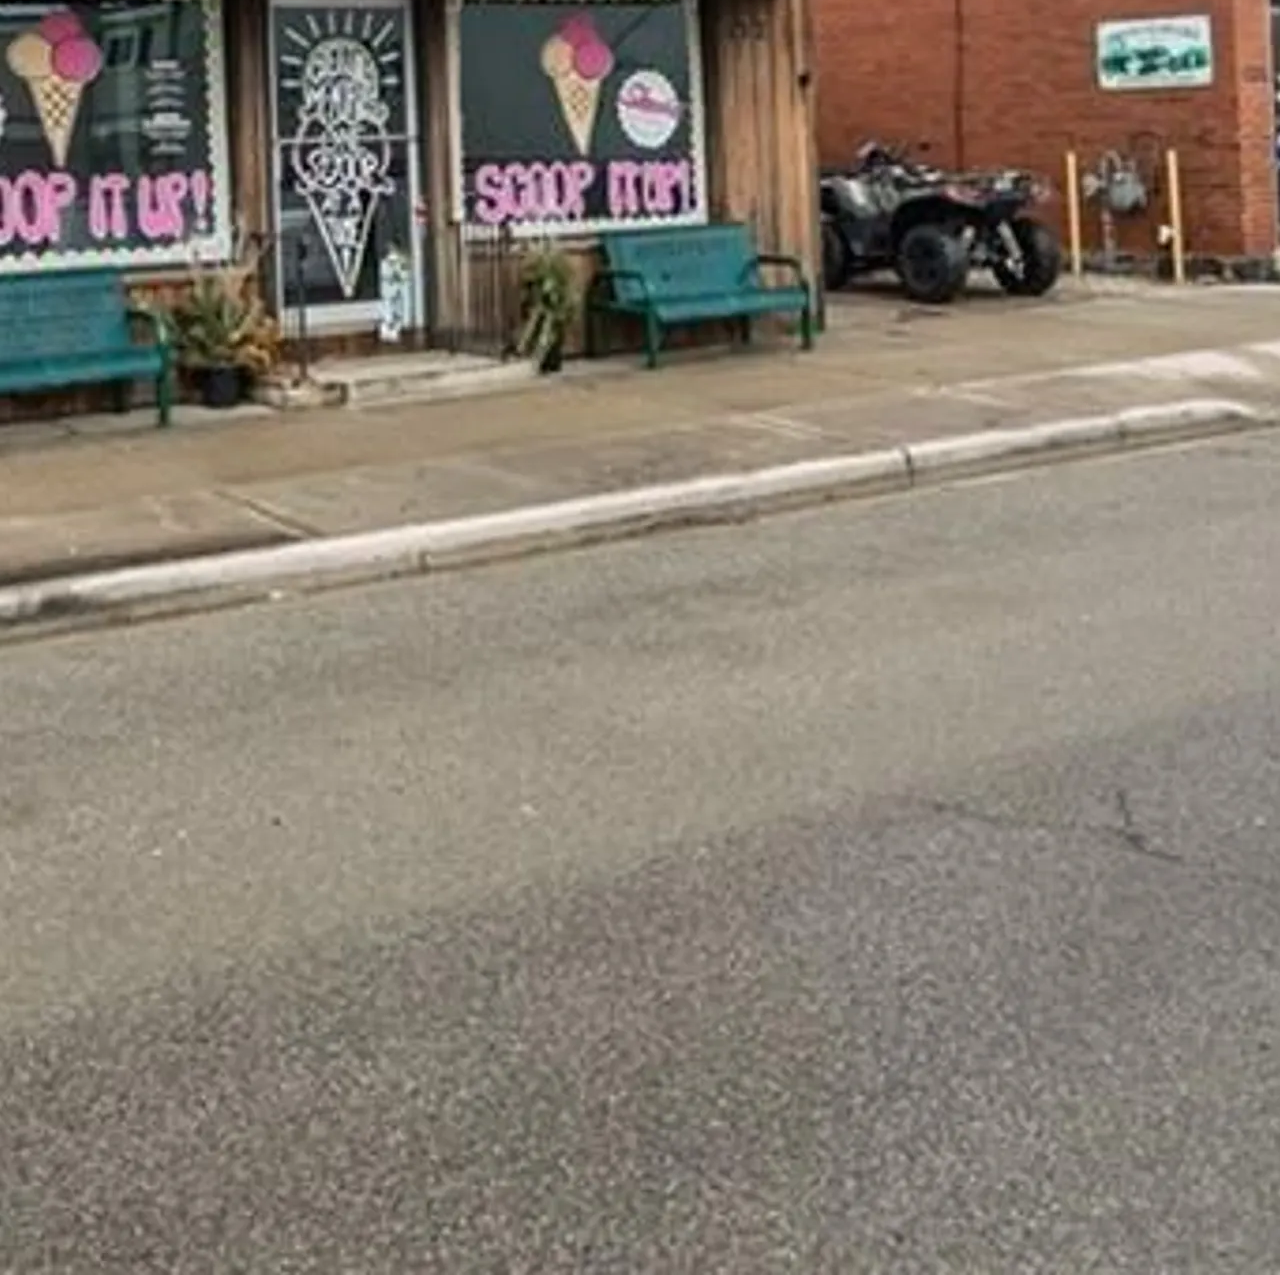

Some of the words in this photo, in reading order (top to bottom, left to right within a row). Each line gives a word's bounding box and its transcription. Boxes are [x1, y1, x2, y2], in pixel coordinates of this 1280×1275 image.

[88, 173, 130, 241] IT
[136, 169, 212, 239] UP!
[475, 160, 595, 223] SCOOP
[607, 160, 643, 216] IT
